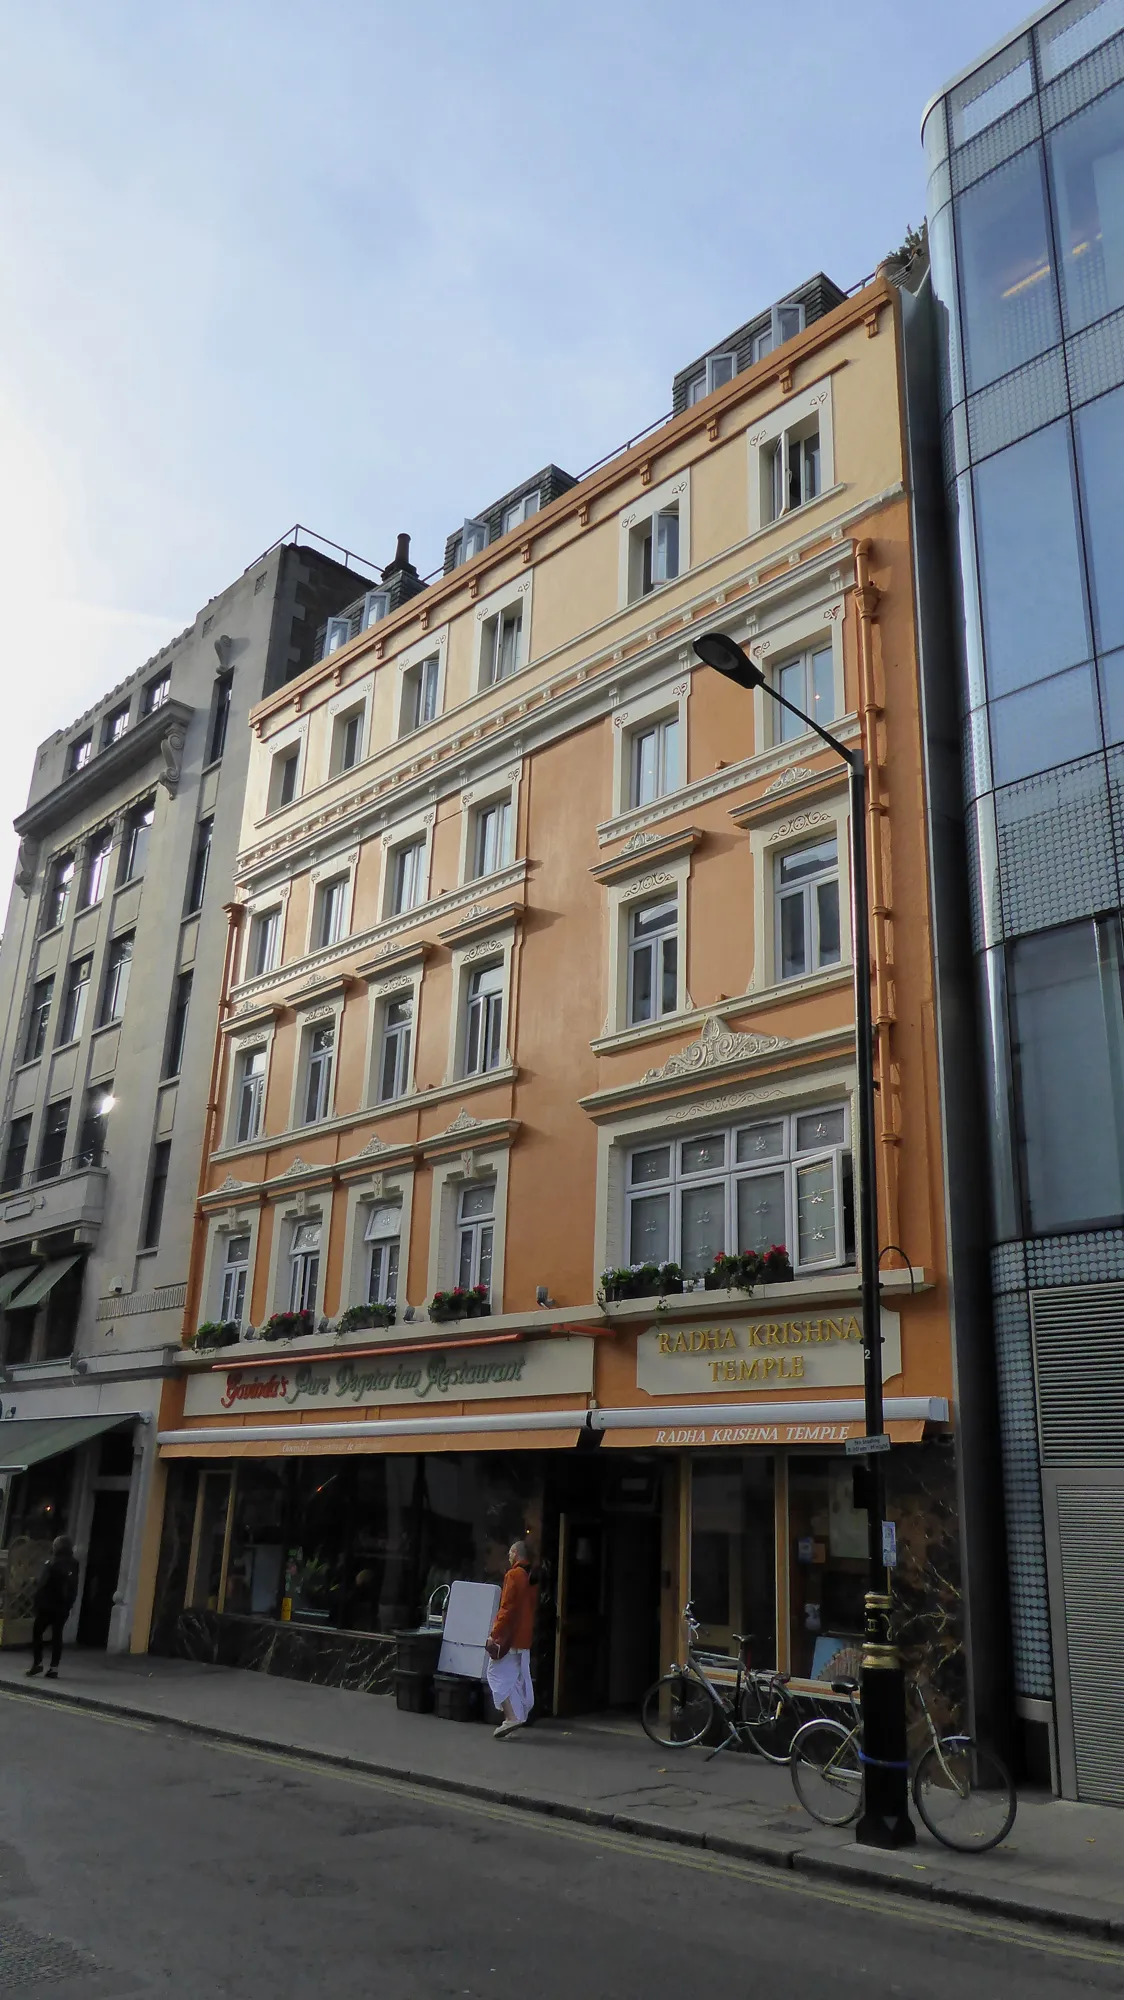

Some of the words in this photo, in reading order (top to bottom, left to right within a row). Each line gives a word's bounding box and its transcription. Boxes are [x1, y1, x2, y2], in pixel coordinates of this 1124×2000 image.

[657, 1327, 737, 1354] RADHA
[748, 1316, 864, 1347] KRISHNA
[864, 1349, 871, 1360] 2
[221, 1370, 289, 1408] Govinda's
[284, 1363, 331, 1404] Pure
[335, 1361, 421, 1402] Vegetarian
[414, 1352, 527, 1398] Restaurant
[708, 1355, 805, 1383] TEMPLE
[656, 1429, 706, 1443] RADHA
[712, 1427, 779, 1442] KRISHNA
[786, 1426, 850, 1440] TEMPLE
